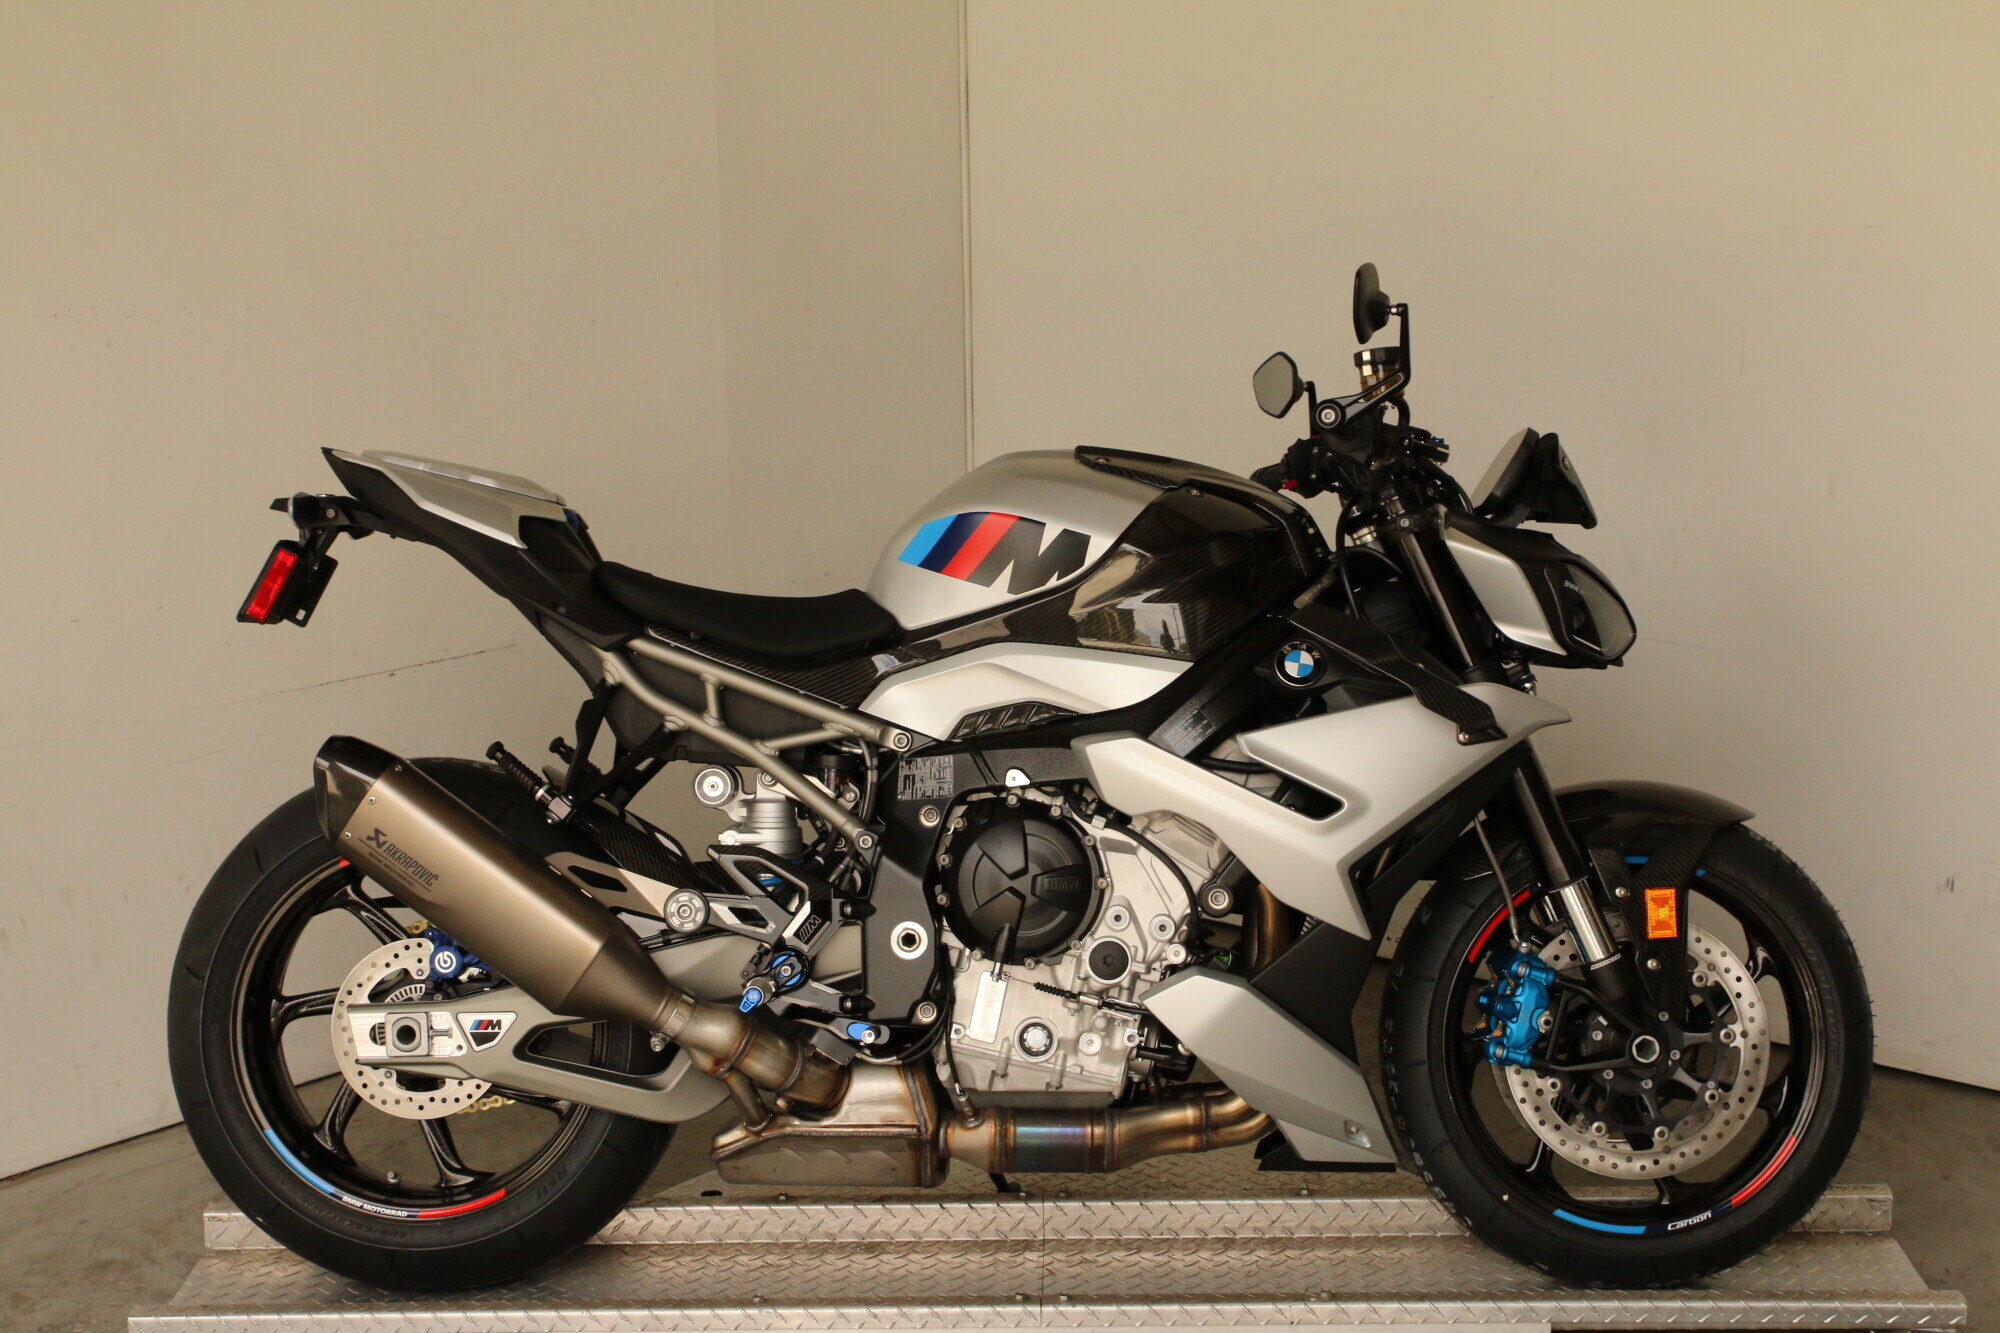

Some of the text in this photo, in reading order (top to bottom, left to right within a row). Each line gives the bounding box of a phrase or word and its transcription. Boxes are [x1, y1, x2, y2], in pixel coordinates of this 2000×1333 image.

[341, 1195, 408, 1217] BMW MOTORRAD
[1667, 1210, 1712, 1231] Carbon
